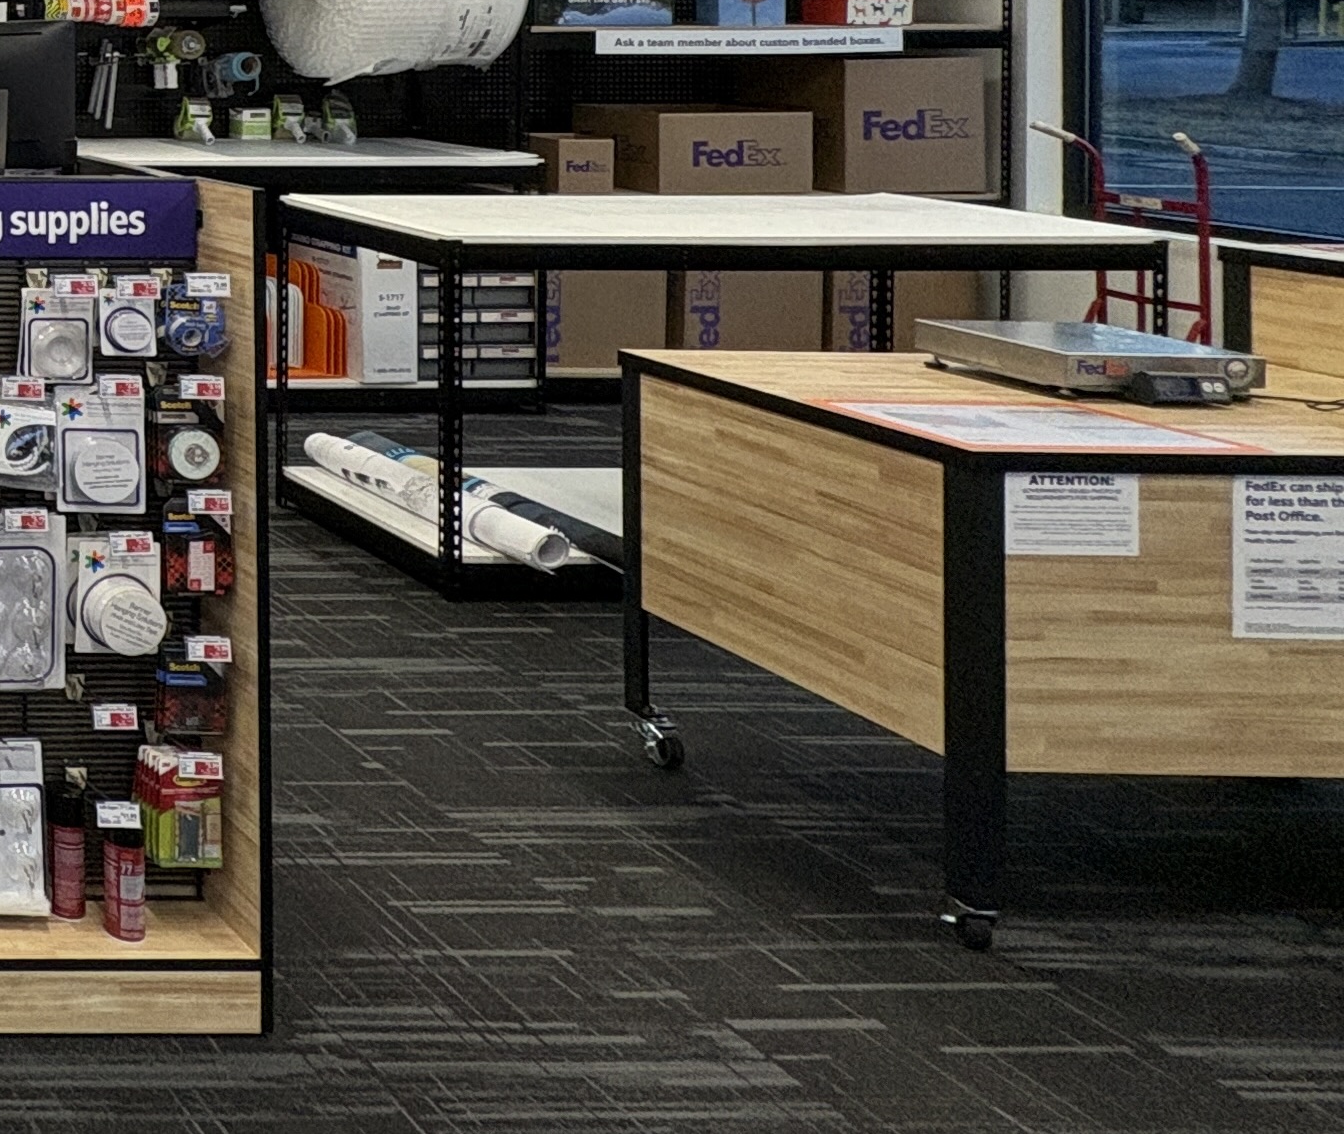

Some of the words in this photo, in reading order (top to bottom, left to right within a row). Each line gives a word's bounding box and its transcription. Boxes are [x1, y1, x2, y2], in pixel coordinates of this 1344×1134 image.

[615, 36, 635, 48] Ask
[637, 39, 644, 48] a
[647, 38, 675, 48] team
[678, 37, 723, 48] member
[726, 36, 758, 48] about
[760, 37, 799, 48] custom
[803, 36, 847, 46] branded
[850, 35, 885, 46] boxes.
[863, 109, 970, 140] FedEx
[692, 139, 782, 167] FedEx
[10, 202, 146, 245] supplies
[170, 301, 200, 310] Scotch
[160, 401, 192, 409] Scotch
[1245, 481, 1287, 492] FedEx
[1290, 483, 1313, 493] can
[1316, 482, 1344, 495] ship
[1246, 495, 1265, 507] for
[1268, 496, 1295, 507] less
[1298, 496, 1328, 508] than
[1245, 510, 1276, 521] Post
[1278, 511, 1324, 522] Office.
[169, 662, 201, 671] Scotch
